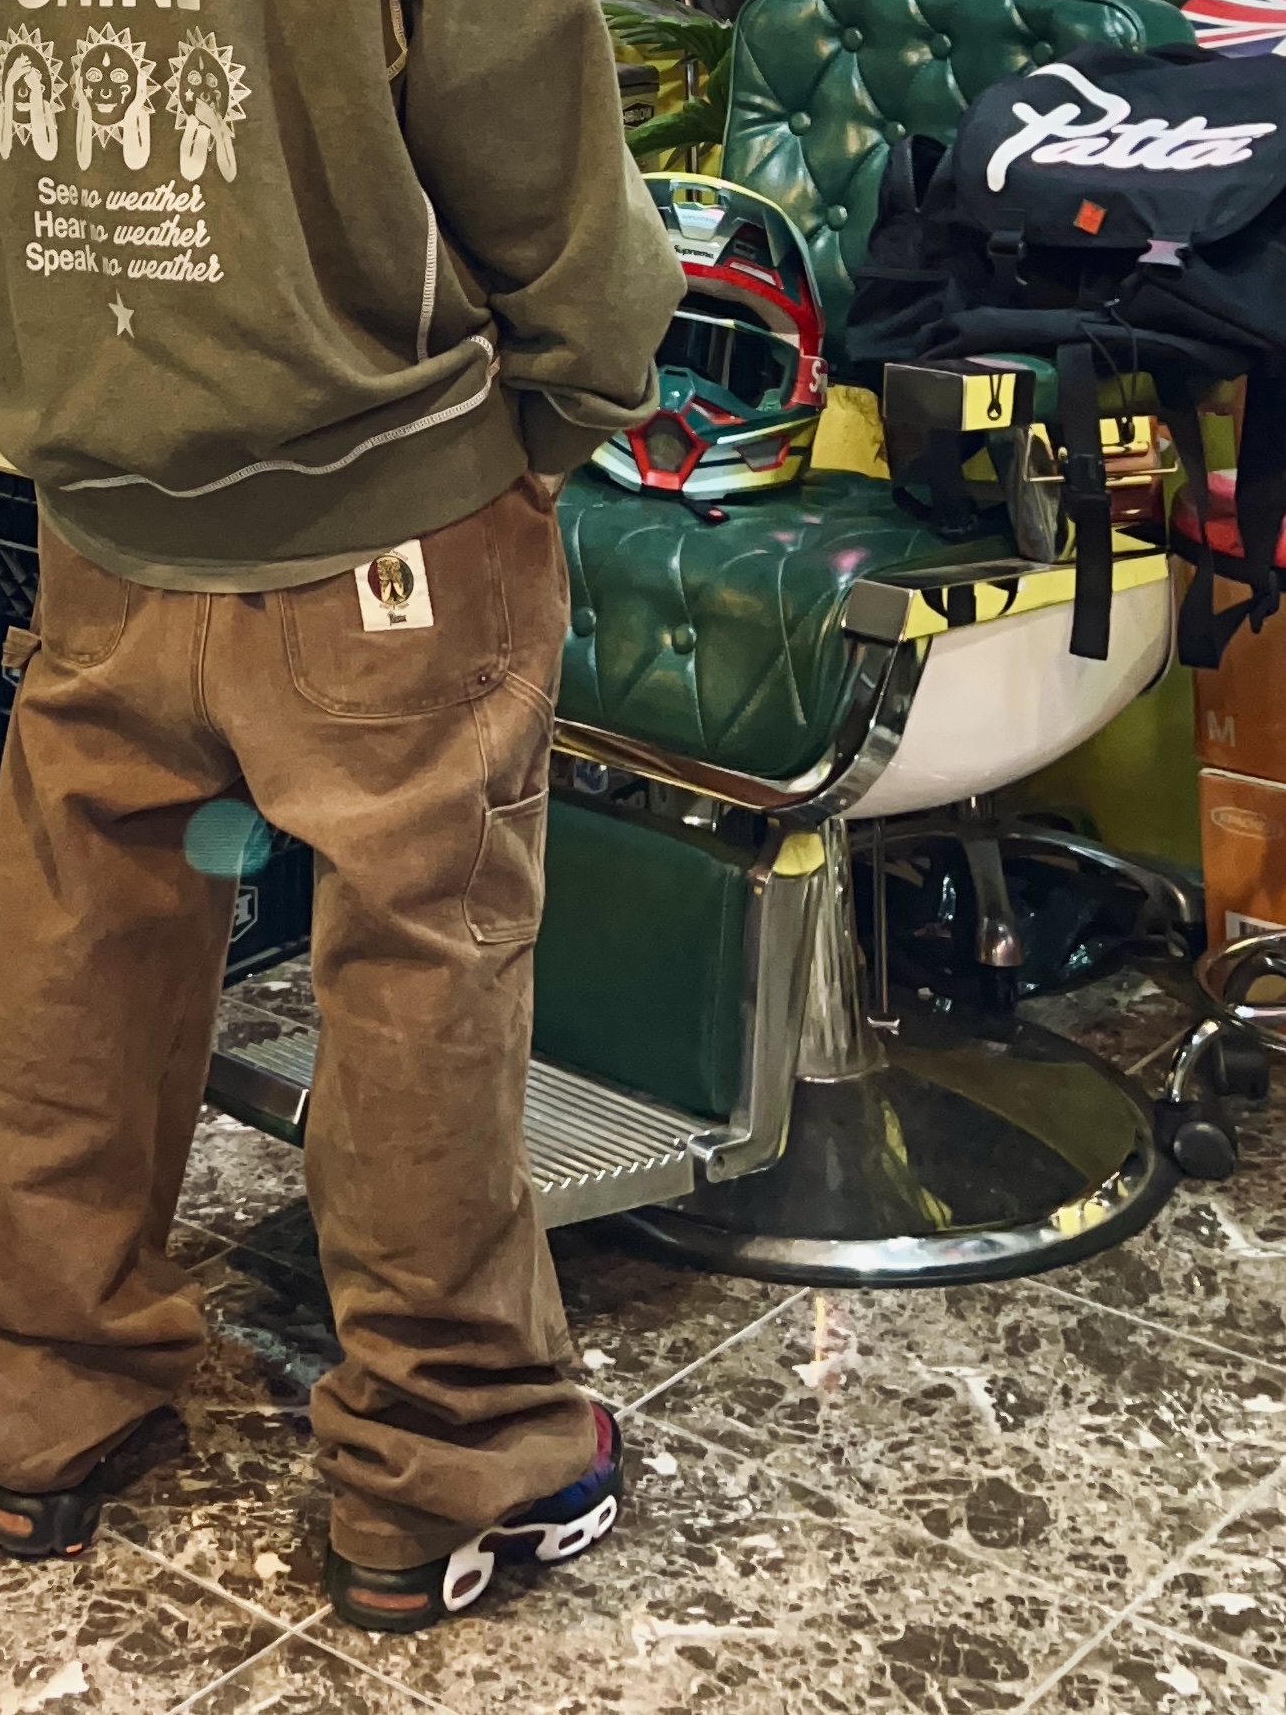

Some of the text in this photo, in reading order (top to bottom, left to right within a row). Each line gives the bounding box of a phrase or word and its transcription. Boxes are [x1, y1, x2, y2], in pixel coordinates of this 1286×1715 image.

[986, 63, 1278, 192] Patta
[37, 177, 206, 213] See no weather
[34, 210, 211, 248] Hear no weather
[25, 242, 225, 283] Speak no weather
[1207, 711, 1236, 748] M
